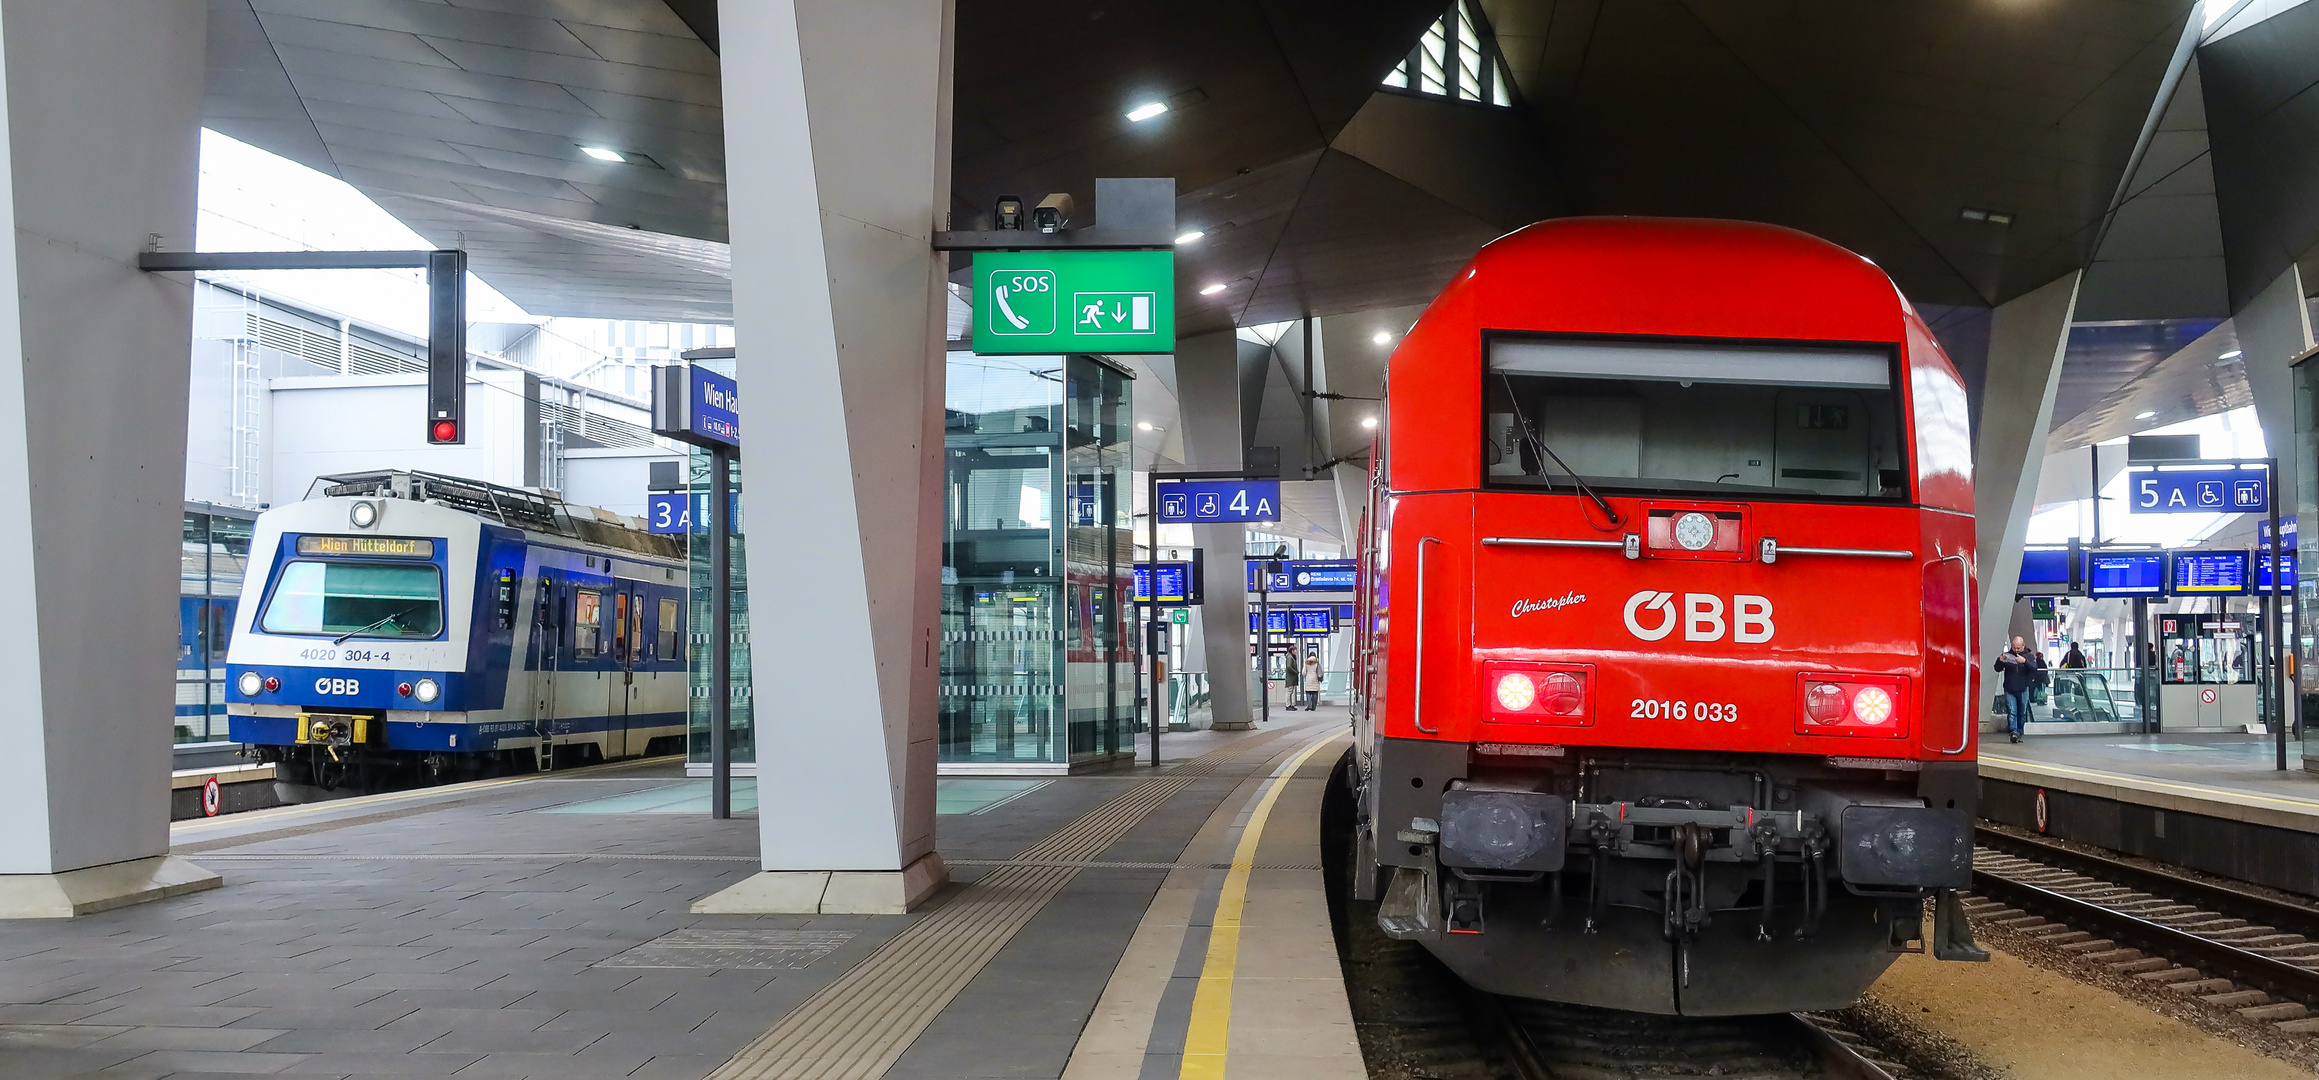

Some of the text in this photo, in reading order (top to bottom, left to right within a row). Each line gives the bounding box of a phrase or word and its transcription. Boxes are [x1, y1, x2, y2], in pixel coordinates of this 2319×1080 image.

[1012, 276, 1049, 293] SOS
[703, 381, 724, 410] Wien
[1229, 489, 1273, 516] 4 A
[2140, 479, 2187, 508] 5 A
[655, 502, 693, 528] 3 A
[321, 537, 415, 553] Wien Hütteldorf
[1511, 590, 1587, 618] Christopher
[1623, 589, 1776, 644] ÖBB
[300, 648, 391, 662] 4020 304-4
[315, 677, 360, 696] ÖBB
[1630, 698, 1738, 723] 2016 033
